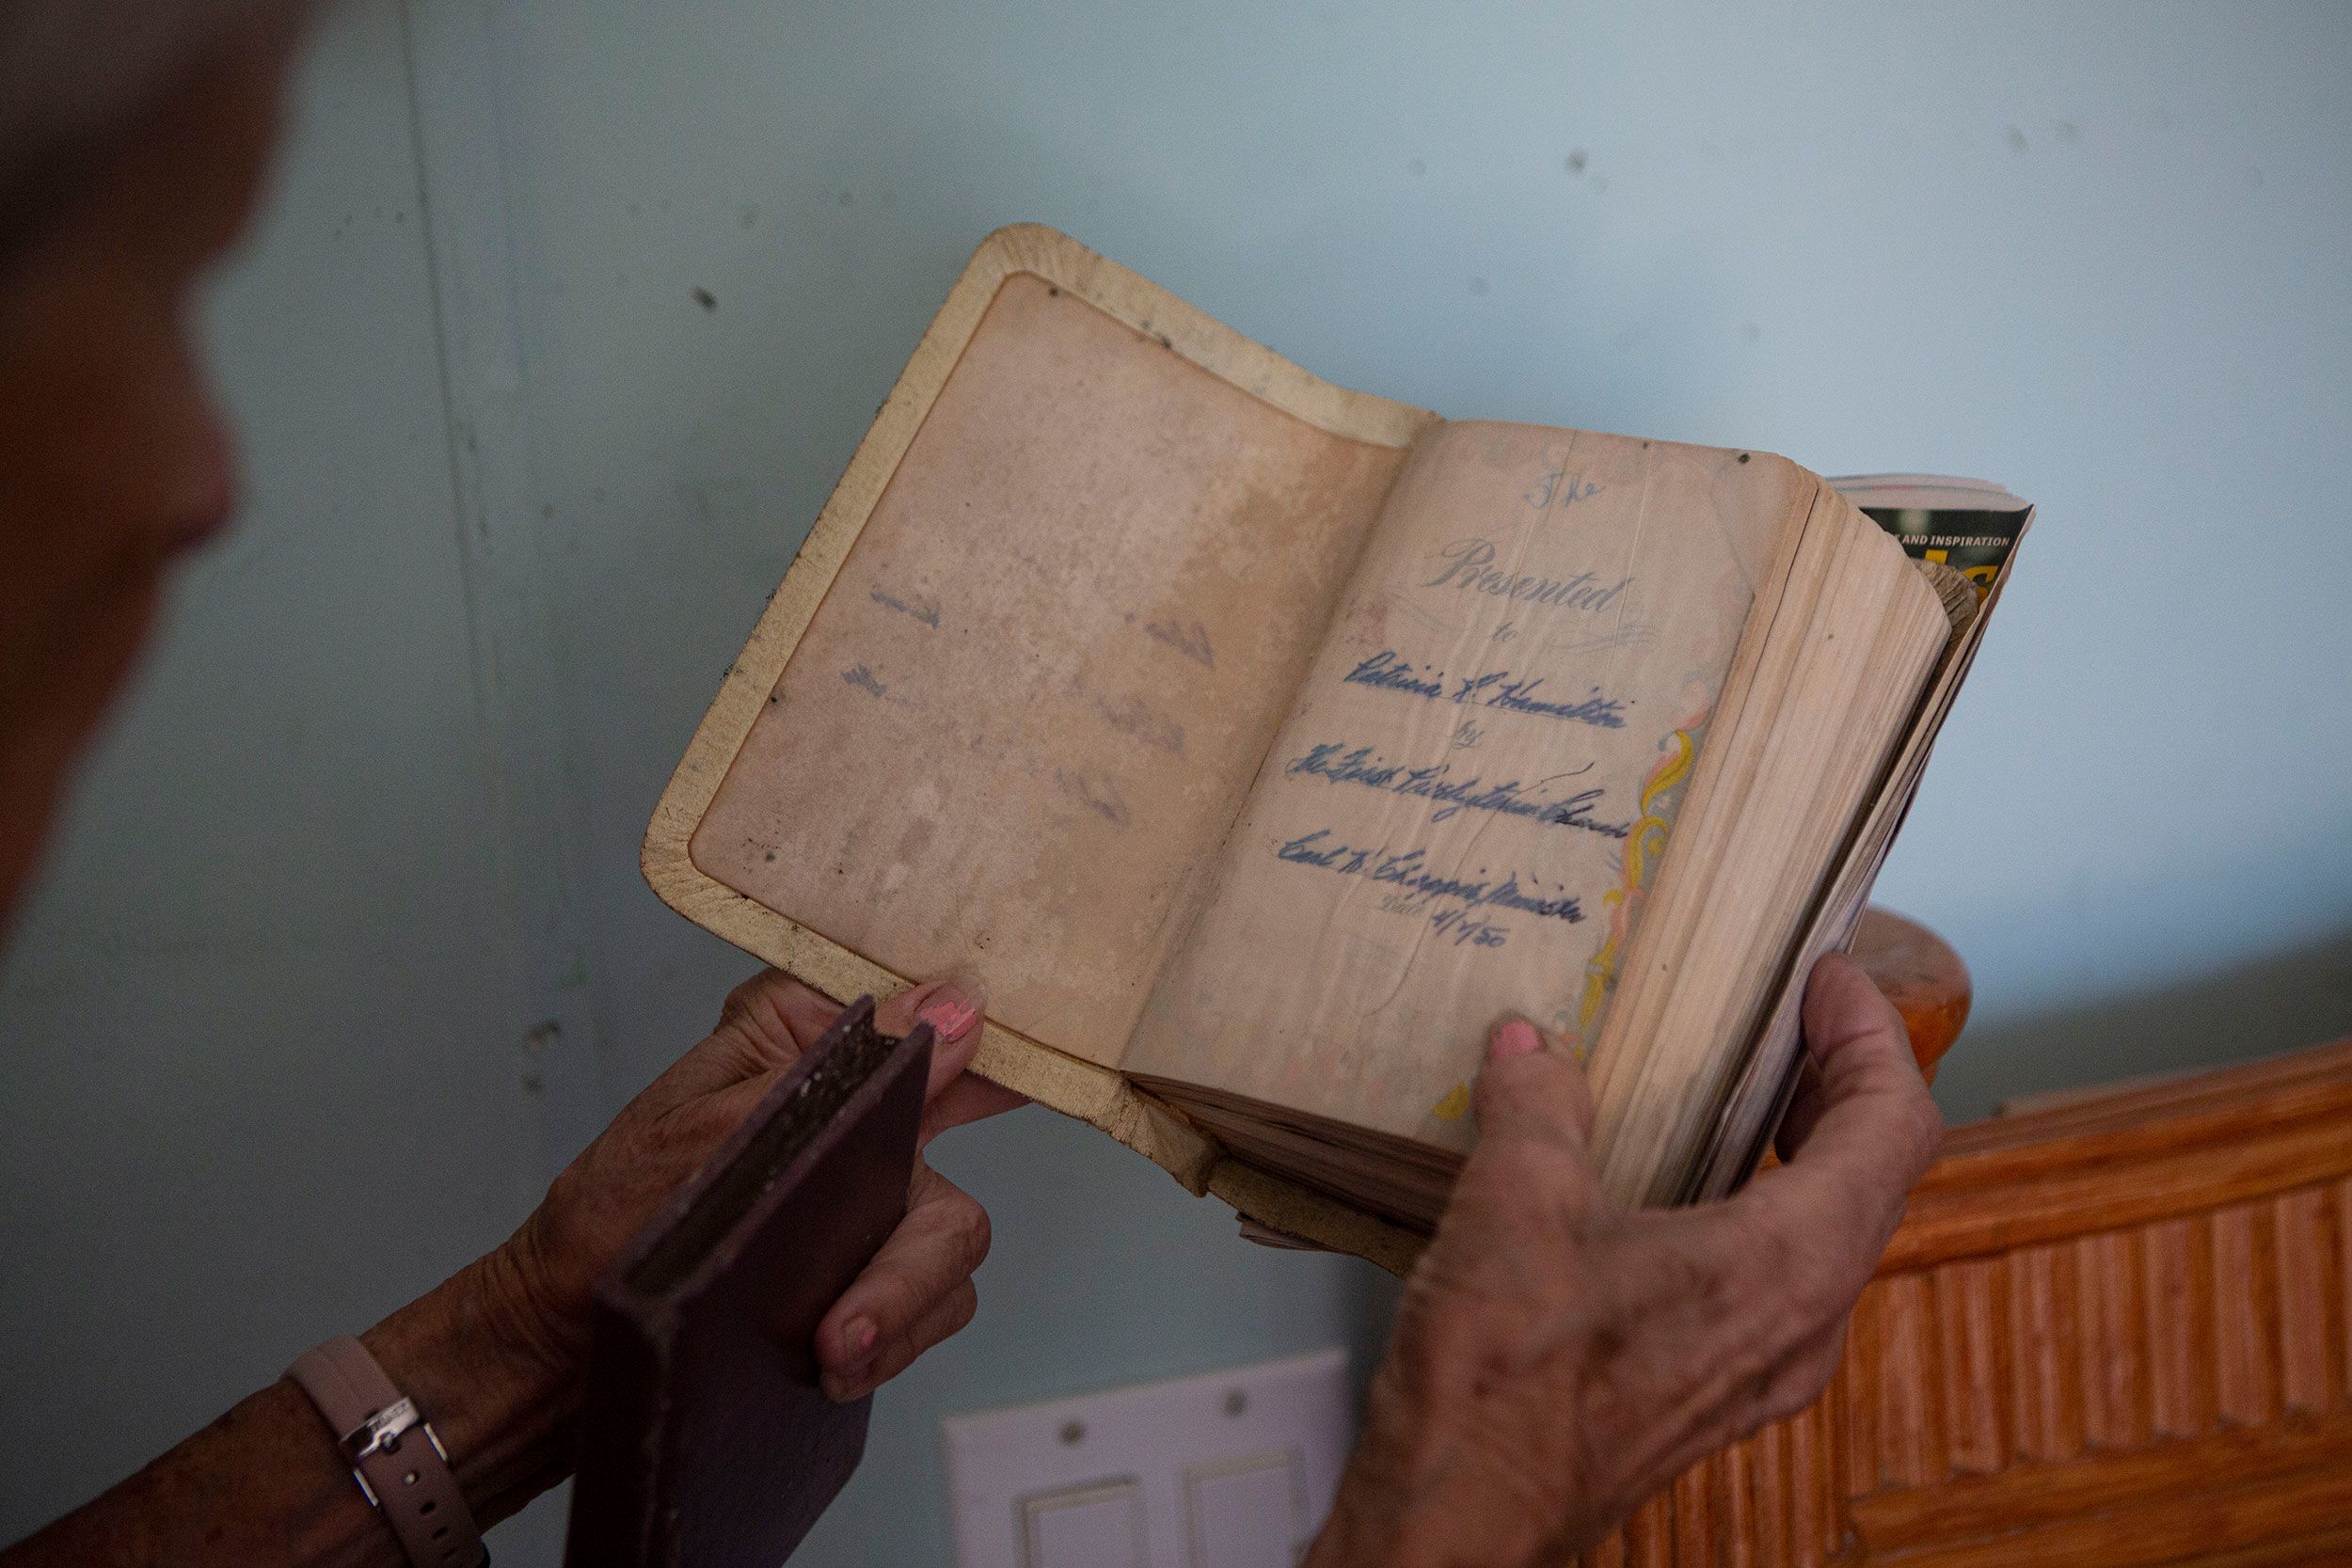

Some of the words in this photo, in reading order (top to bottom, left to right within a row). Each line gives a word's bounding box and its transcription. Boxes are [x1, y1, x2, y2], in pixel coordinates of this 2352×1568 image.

[1902, 534, 1928, 545] AND
[1931, 535, 2010, 546] INSPIRATION
[1422, 538, 1635, 613] Presented
[1491, 621, 1518, 643] to
